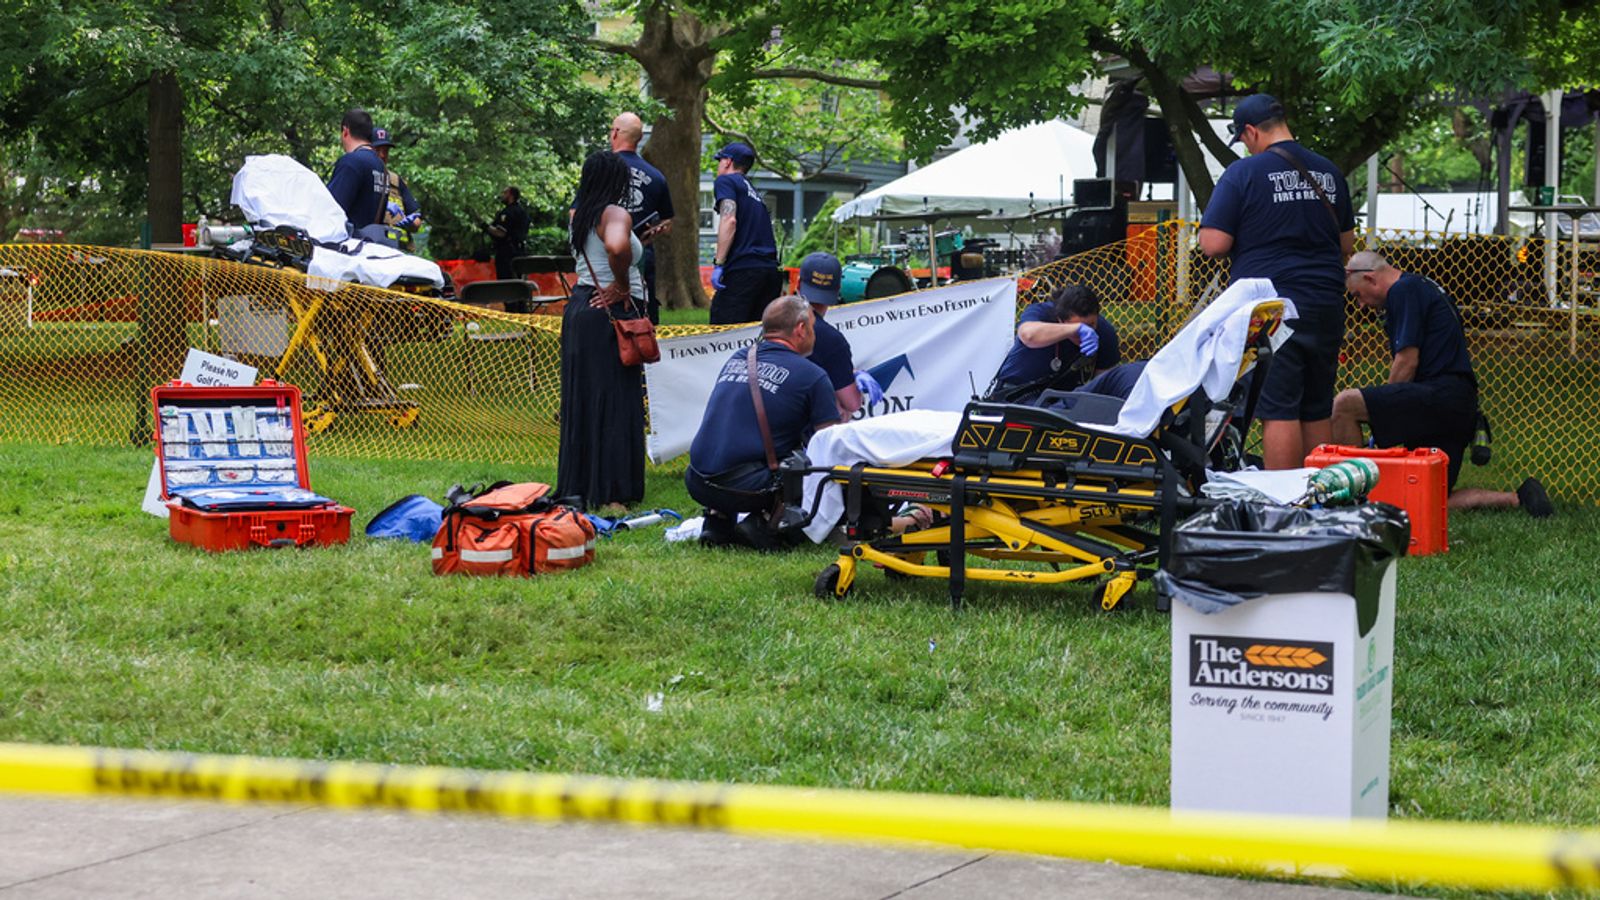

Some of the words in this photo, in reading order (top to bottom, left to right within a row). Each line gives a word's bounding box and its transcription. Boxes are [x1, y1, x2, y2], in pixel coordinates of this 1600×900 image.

[1273, 191, 1295, 203] FIRE
[858, 315, 885, 327] OLD
[886, 308, 917, 321] WEST
[918, 304, 943, 317] END
[201, 360, 225, 376] Please
[226, 368, 239, 379] NO
[196, 374, 213, 386] Golf
[1050, 437, 1078, 449] XPS
[1194, 638, 1242, 663] The
[1195, 661, 1330, 691] Andersons
[1189, 692, 1238, 714] Serving
[1241, 695, 1261, 710] the
[1264, 701, 1334, 721] community
[1240, 713, 1265, 722] SINCE
[1267, 714, 1286, 723] 1947
